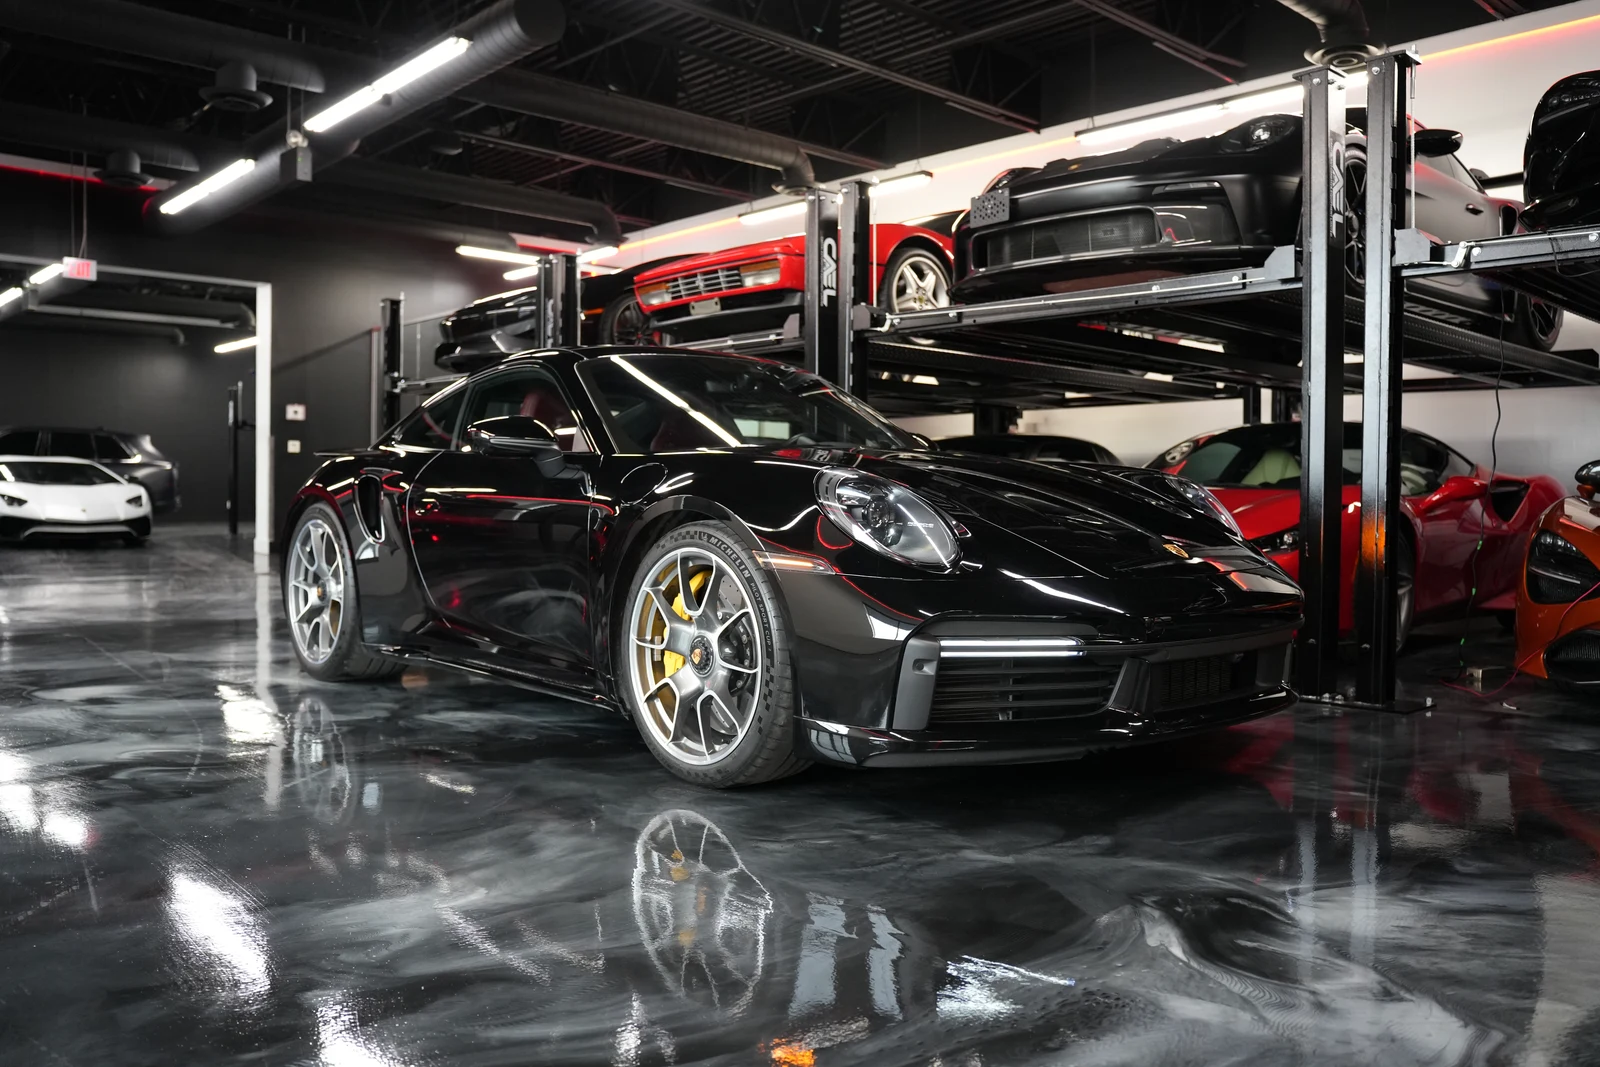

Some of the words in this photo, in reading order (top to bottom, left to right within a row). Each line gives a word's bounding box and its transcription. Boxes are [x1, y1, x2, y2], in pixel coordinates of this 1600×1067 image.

[709, 536, 751, 579] MICHELIN
[750, 582, 761, 601] PILOT
[760, 603, 769, 628] SPORT
